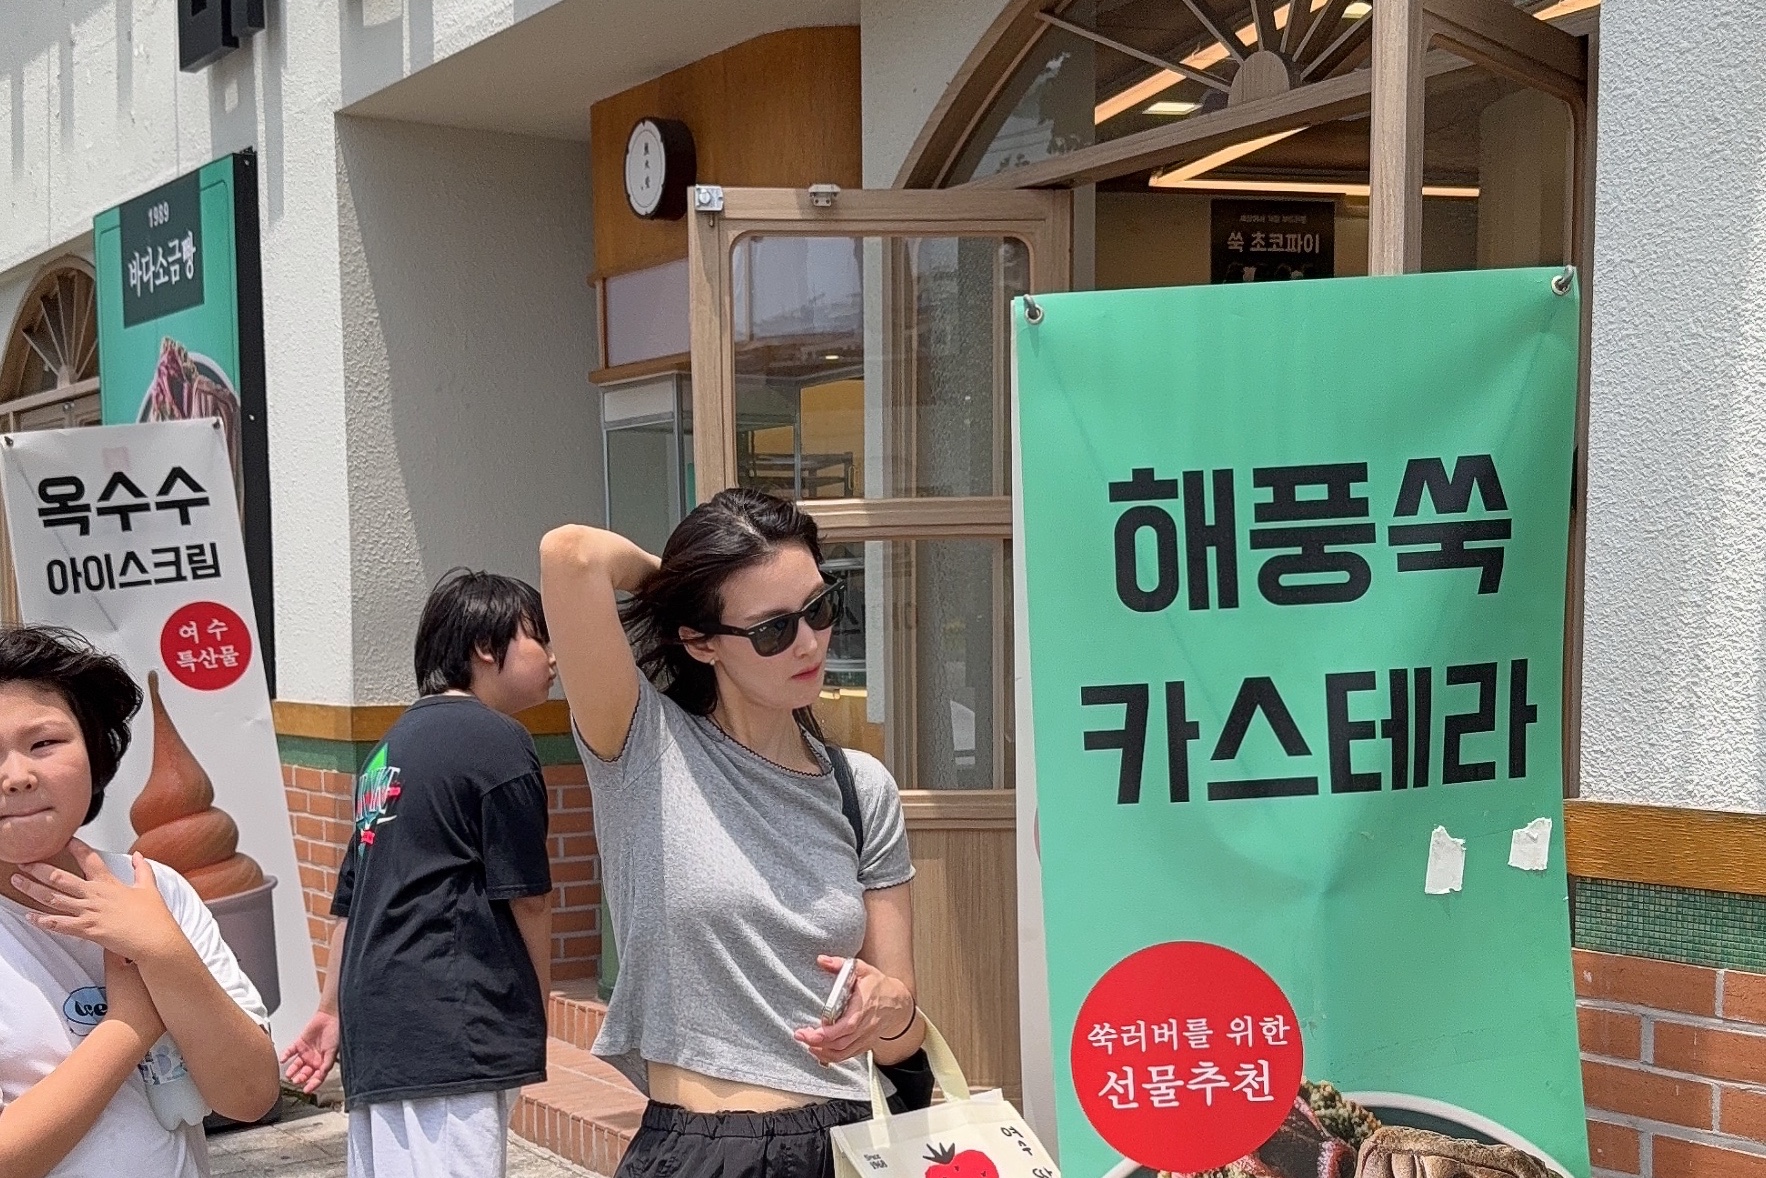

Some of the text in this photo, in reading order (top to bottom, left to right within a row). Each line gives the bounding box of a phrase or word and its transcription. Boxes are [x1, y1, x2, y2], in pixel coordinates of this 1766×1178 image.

[148, 202, 170, 228] 1989
[128, 230, 197, 297] 바다소금빵
[1226, 230, 1320, 254] 쑥 초코파이
[38, 466, 210, 536] 옥수수
[1109, 454, 1512, 613] 해풍쑥
[47, 542, 222, 596] 아이스크림
[178, 618, 229, 645] 여수
[176, 644, 240, 673] 특산물
[1081, 658, 1538, 805] 카스테라
[1087, 1014, 1291, 1055] 쑥러버를 위한
[1098, 1059, 1275, 1110] 선물추천
